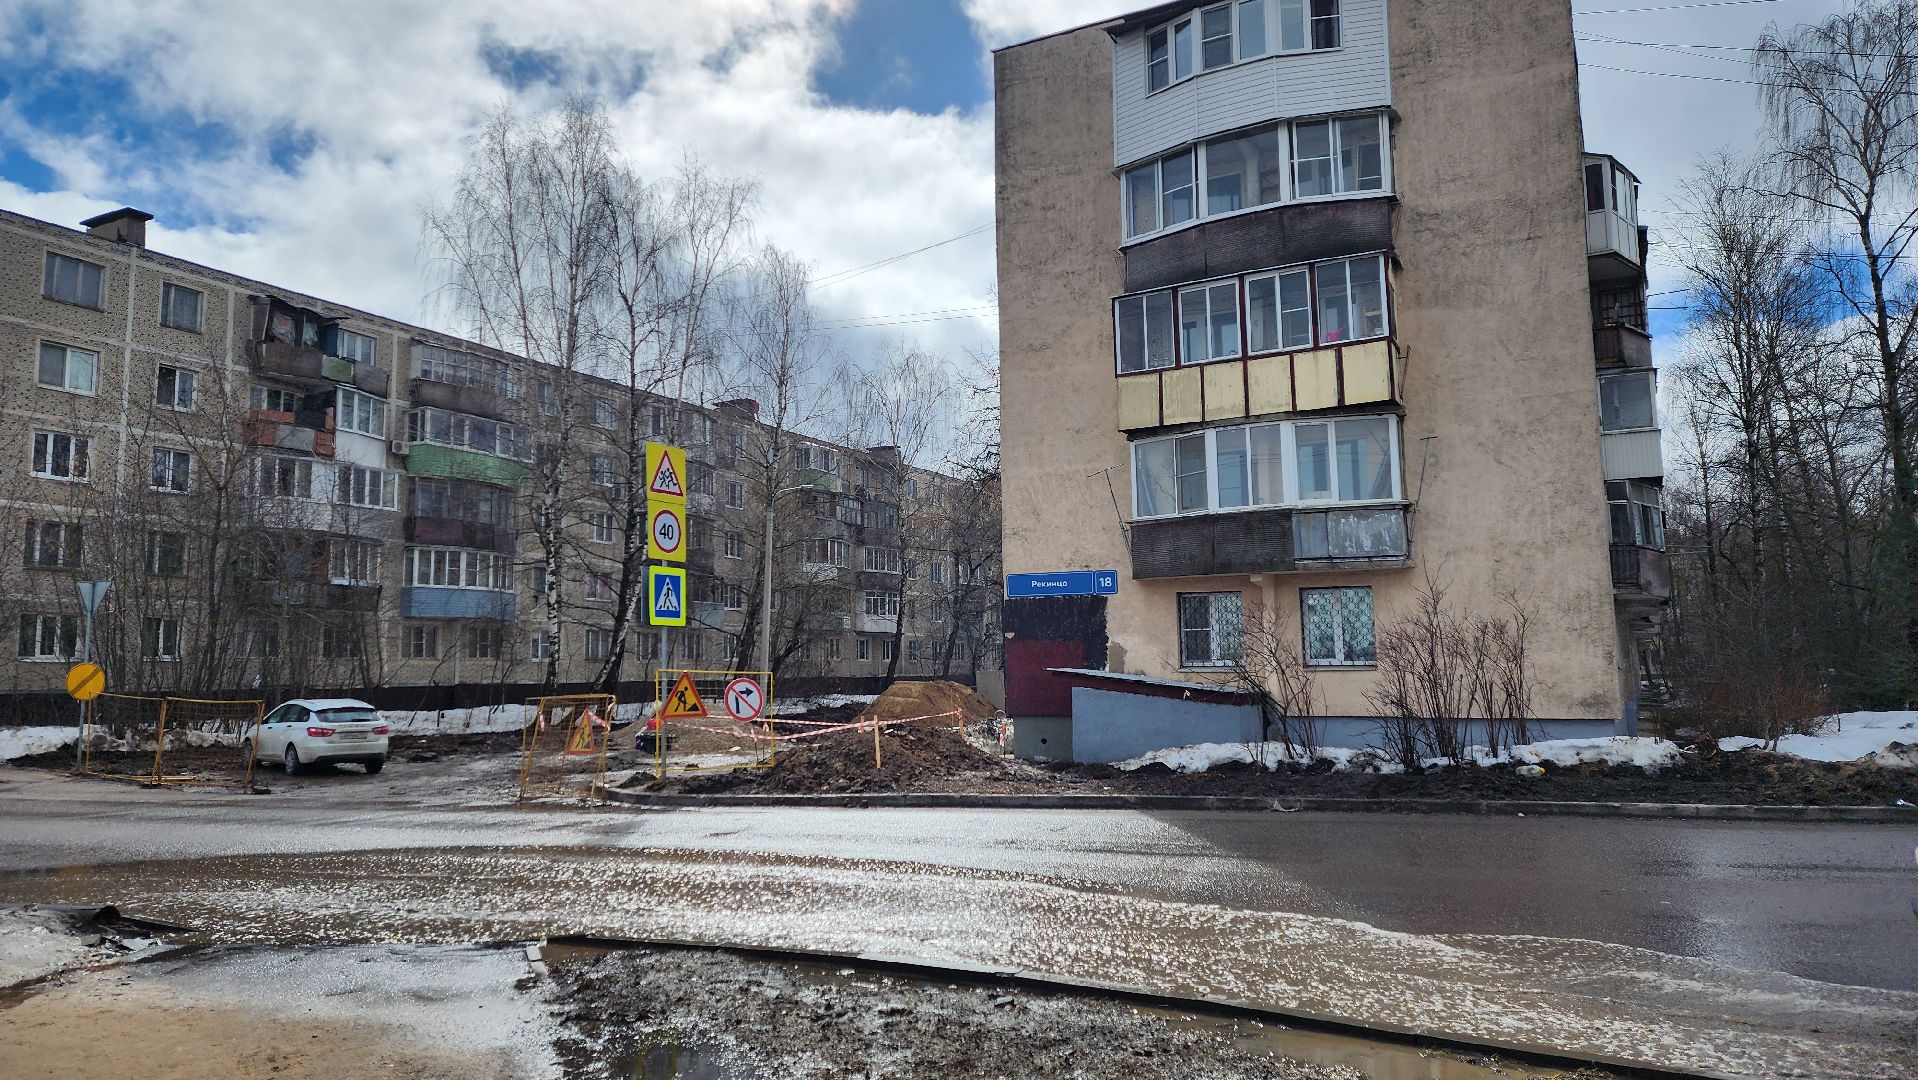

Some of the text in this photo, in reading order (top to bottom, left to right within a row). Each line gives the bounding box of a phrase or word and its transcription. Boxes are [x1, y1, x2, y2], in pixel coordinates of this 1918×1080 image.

[659, 523, 674, 540] 40
[1031, 580, 1068, 588] Рекинцо
[1099, 576, 1113, 588] 18
